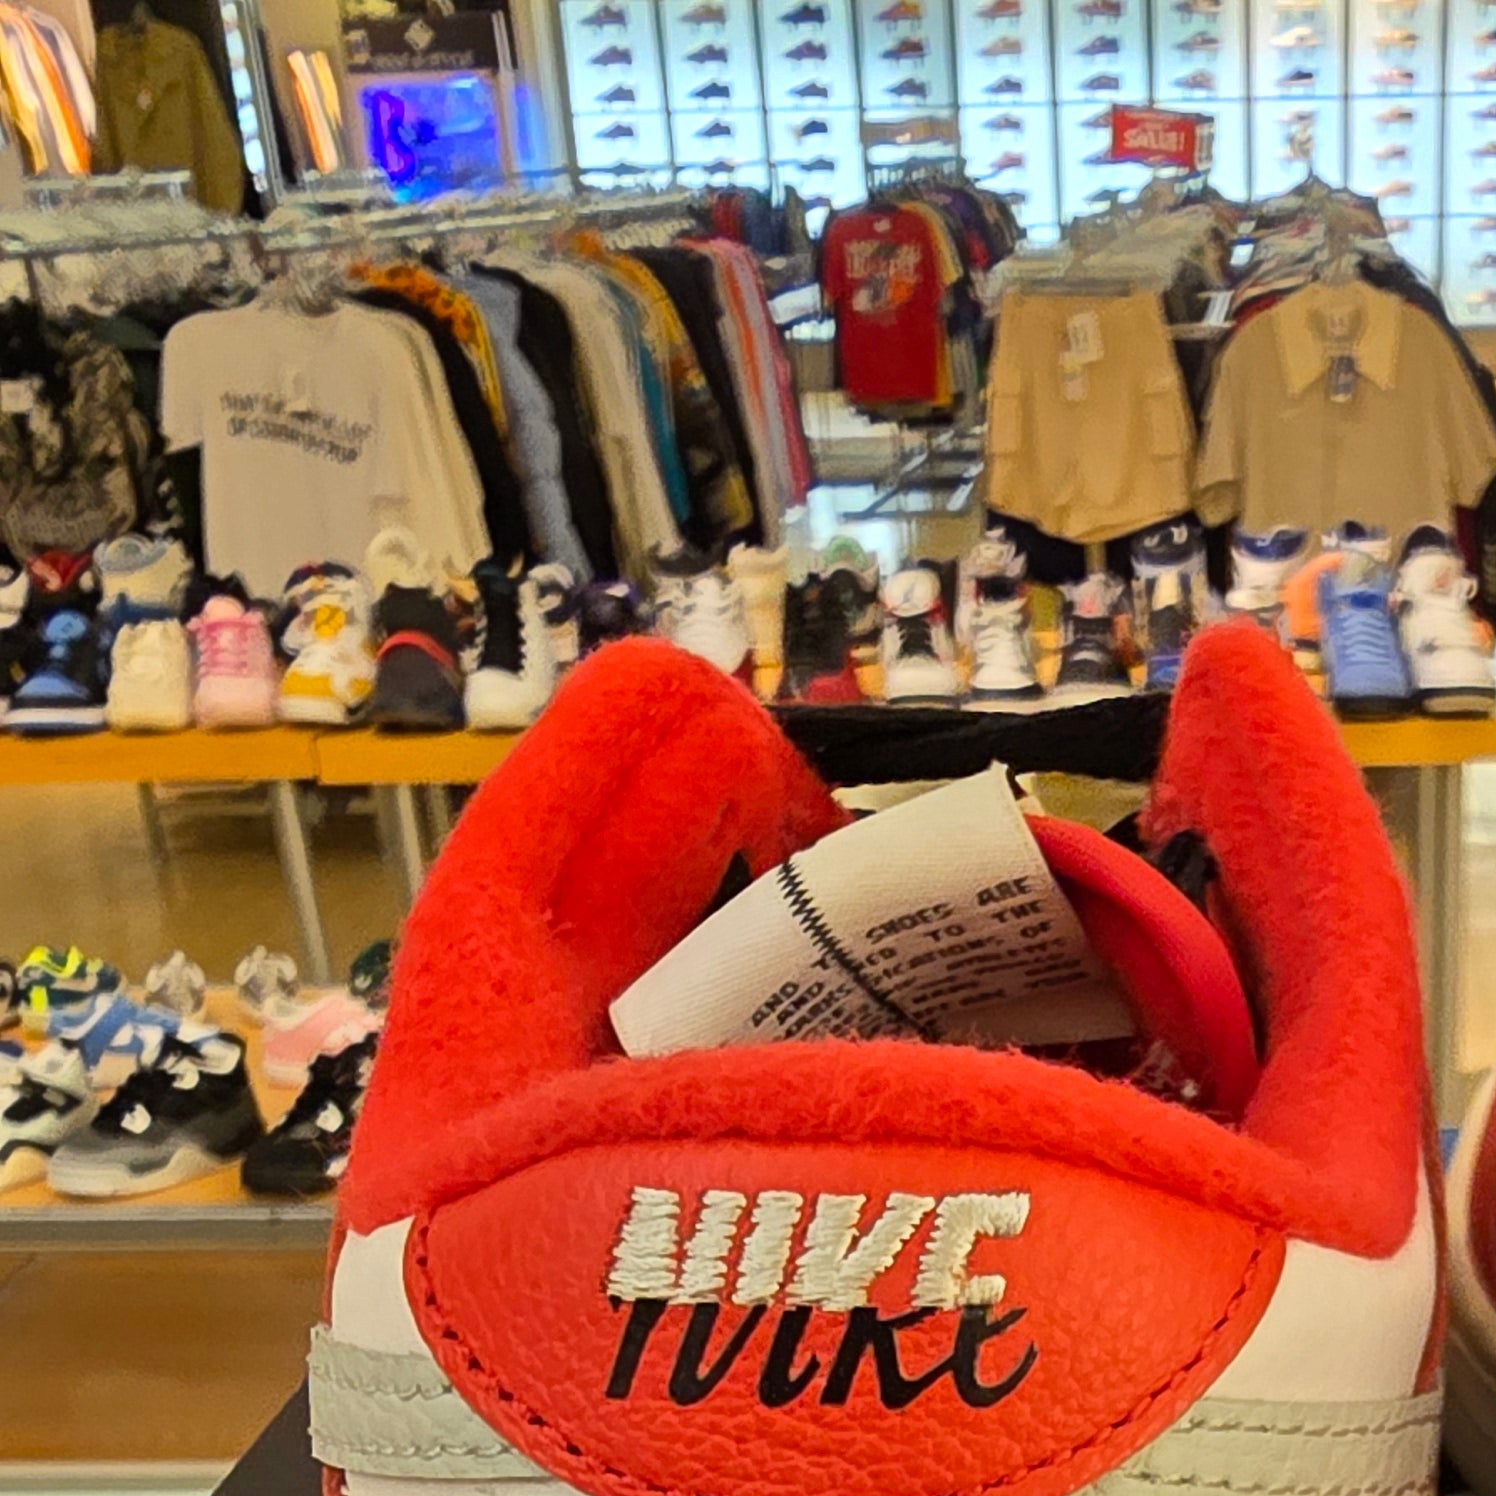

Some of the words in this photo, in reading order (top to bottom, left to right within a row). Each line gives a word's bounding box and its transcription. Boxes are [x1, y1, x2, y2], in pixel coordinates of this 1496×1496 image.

[751, 980, 800, 1028] AND
[865, 903, 954, 945] SHOES
[976, 876, 1032, 906] ARE
[776, 982, 825, 1027] AND
[924, 925, 966, 943] TO
[991, 901, 1043, 923] THE
[1019, 918, 1051, 939] OF
